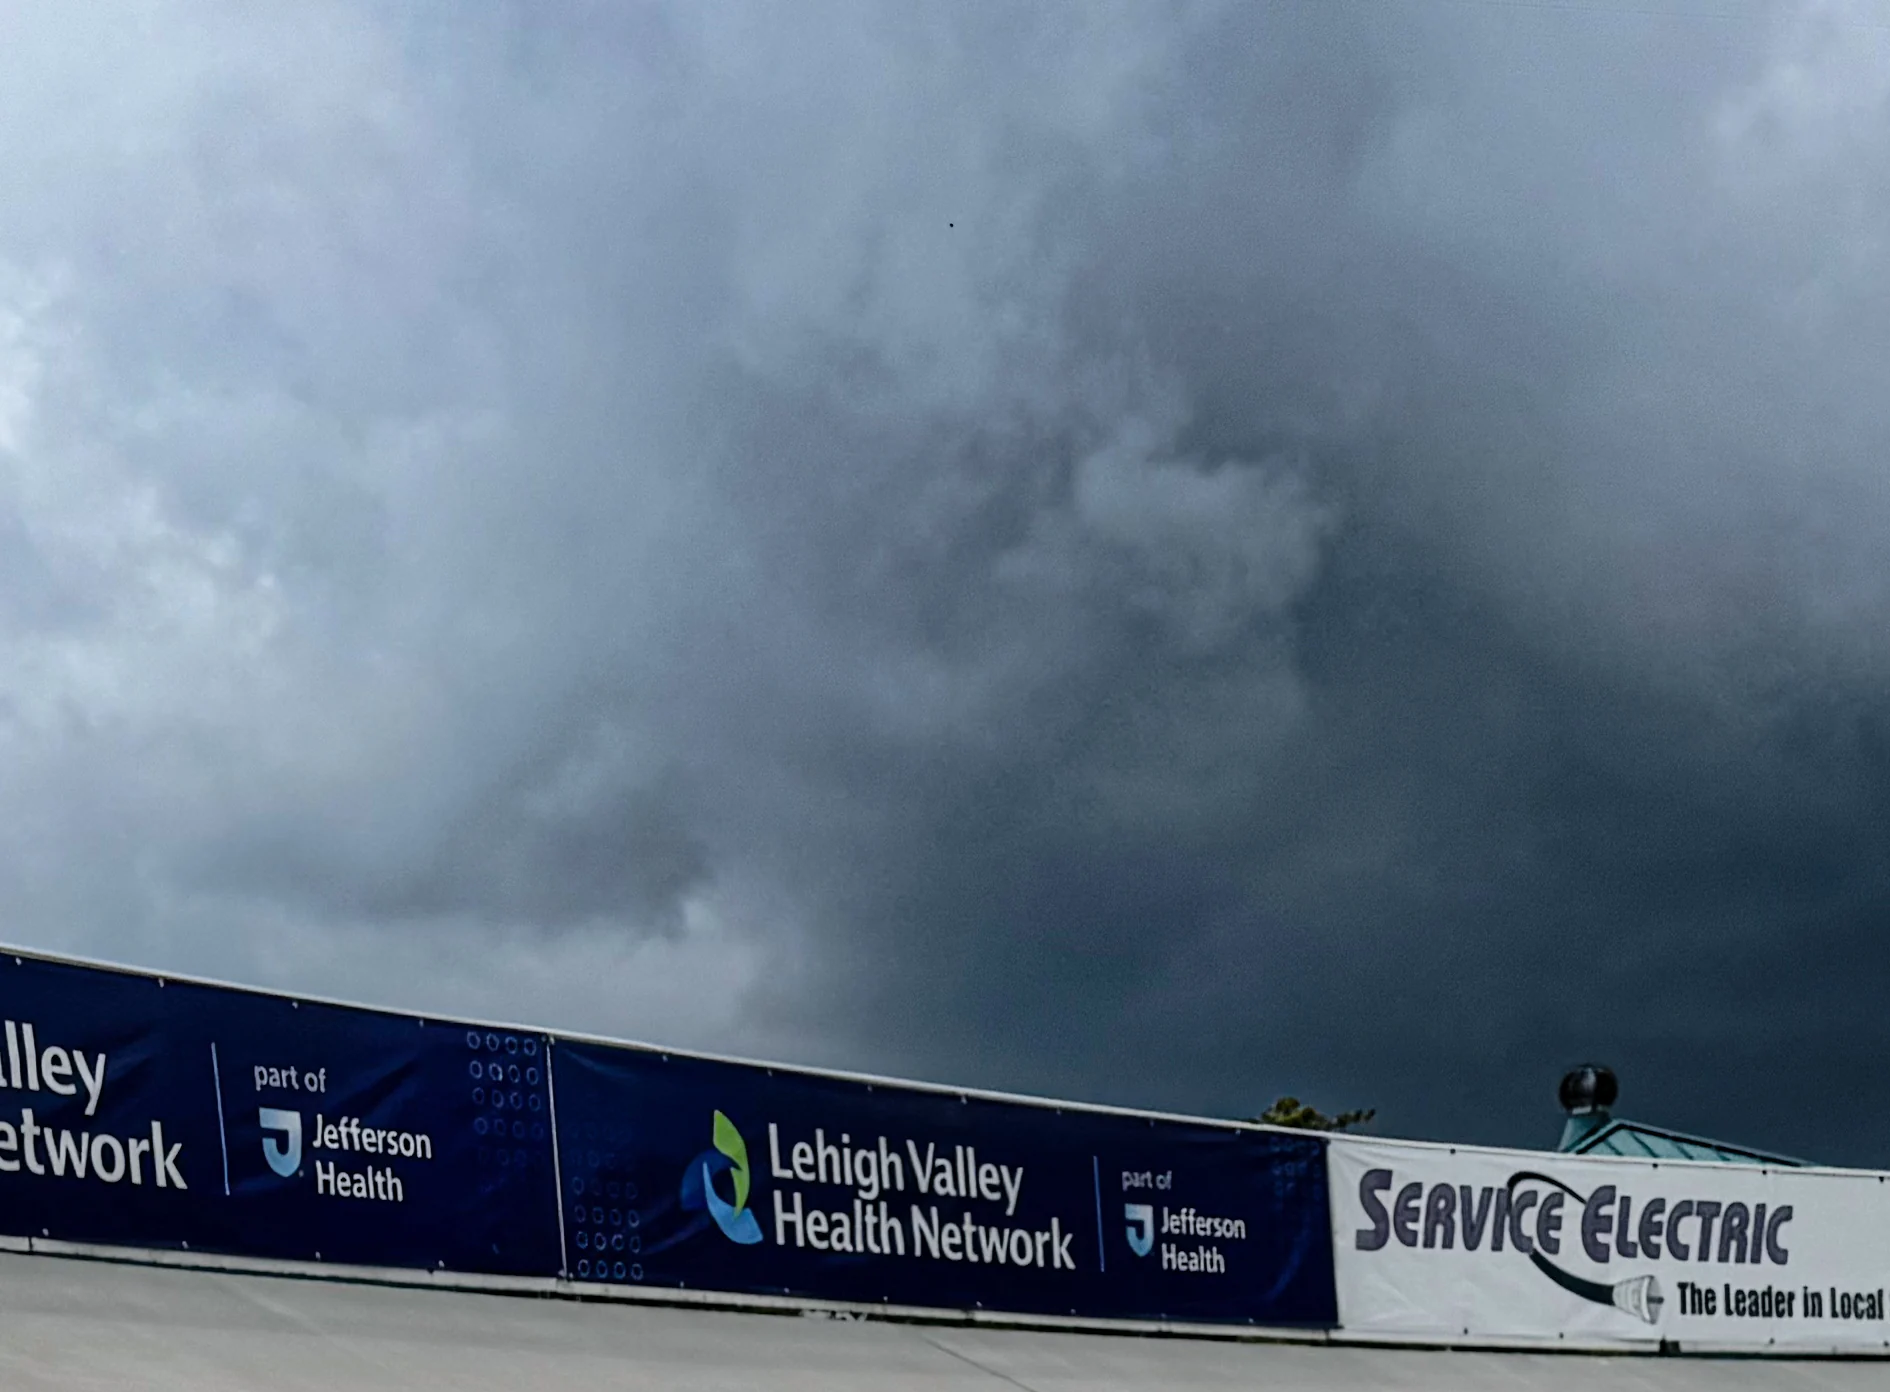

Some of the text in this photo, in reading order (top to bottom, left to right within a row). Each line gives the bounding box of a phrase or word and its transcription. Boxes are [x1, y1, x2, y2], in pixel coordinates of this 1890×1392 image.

[0, 1019, 106, 1116] lley
[254, 1065, 326, 1093] part of
[312, 1113, 432, 1159] Jefferson
[315, 1160, 404, 1202] Health
[768, 1123, 1024, 1217] Lehigh Valley
[1121, 1170, 1173, 1192] part of
[773, 1190, 1076, 1271] Health Network
[1161, 1206, 1246, 1239] Jefferson
[1355, 1168, 1794, 1266] SERVICE ELECTRIC
[1161, 1242, 1226, 1273] Health
[1677, 1281, 1717, 1316] The
[1723, 1283, 1795, 1318] Leader
[1803, 1285, 1823, 1319] in
[1830, 1287, 1884, 1320] Local
